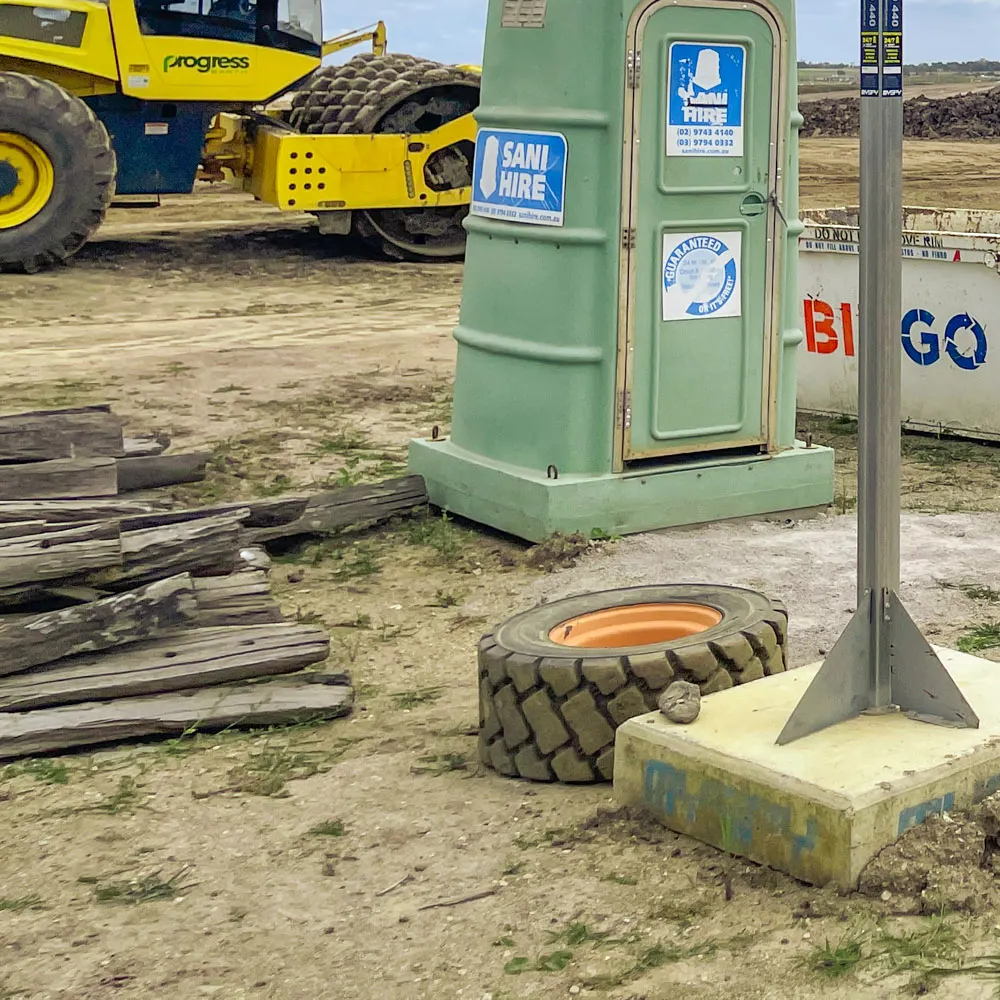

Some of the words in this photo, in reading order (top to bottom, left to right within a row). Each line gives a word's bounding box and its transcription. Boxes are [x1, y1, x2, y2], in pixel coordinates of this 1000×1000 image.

[694, 128, 712, 136] 9743
[694, 139, 712, 147] 9794
[502, 140, 549, 171] SANI
[499, 171, 546, 201] HIRE
[815, 228, 829, 240] DO
[833, 229, 853, 242] NOT
